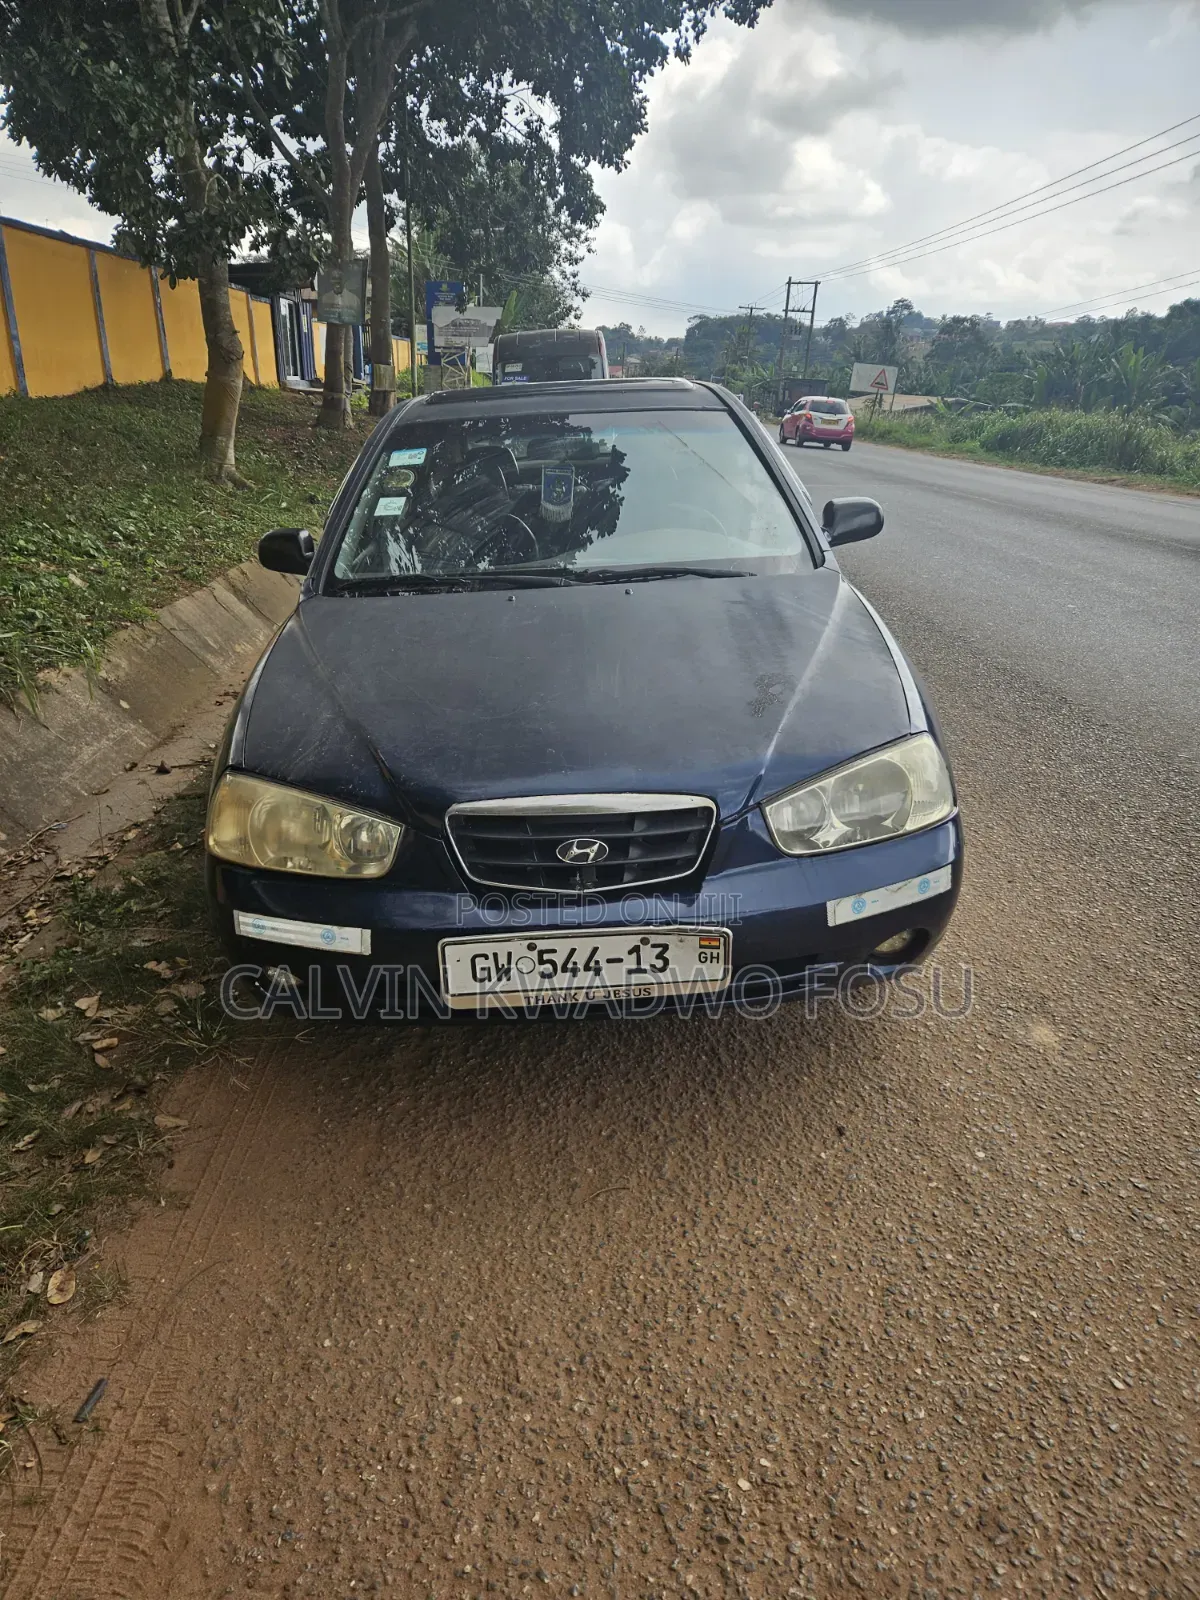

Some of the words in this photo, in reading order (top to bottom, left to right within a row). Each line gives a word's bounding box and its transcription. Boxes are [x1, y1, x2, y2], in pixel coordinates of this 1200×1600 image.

[470, 951, 513, 984] GW
[536, 942, 670, 980] 544-13
[698, 951, 720, 964] GH
[524, 992, 579, 1006] THANK
[585, 989, 596, 1001] U
[602, 987, 652, 1000] JESUS
